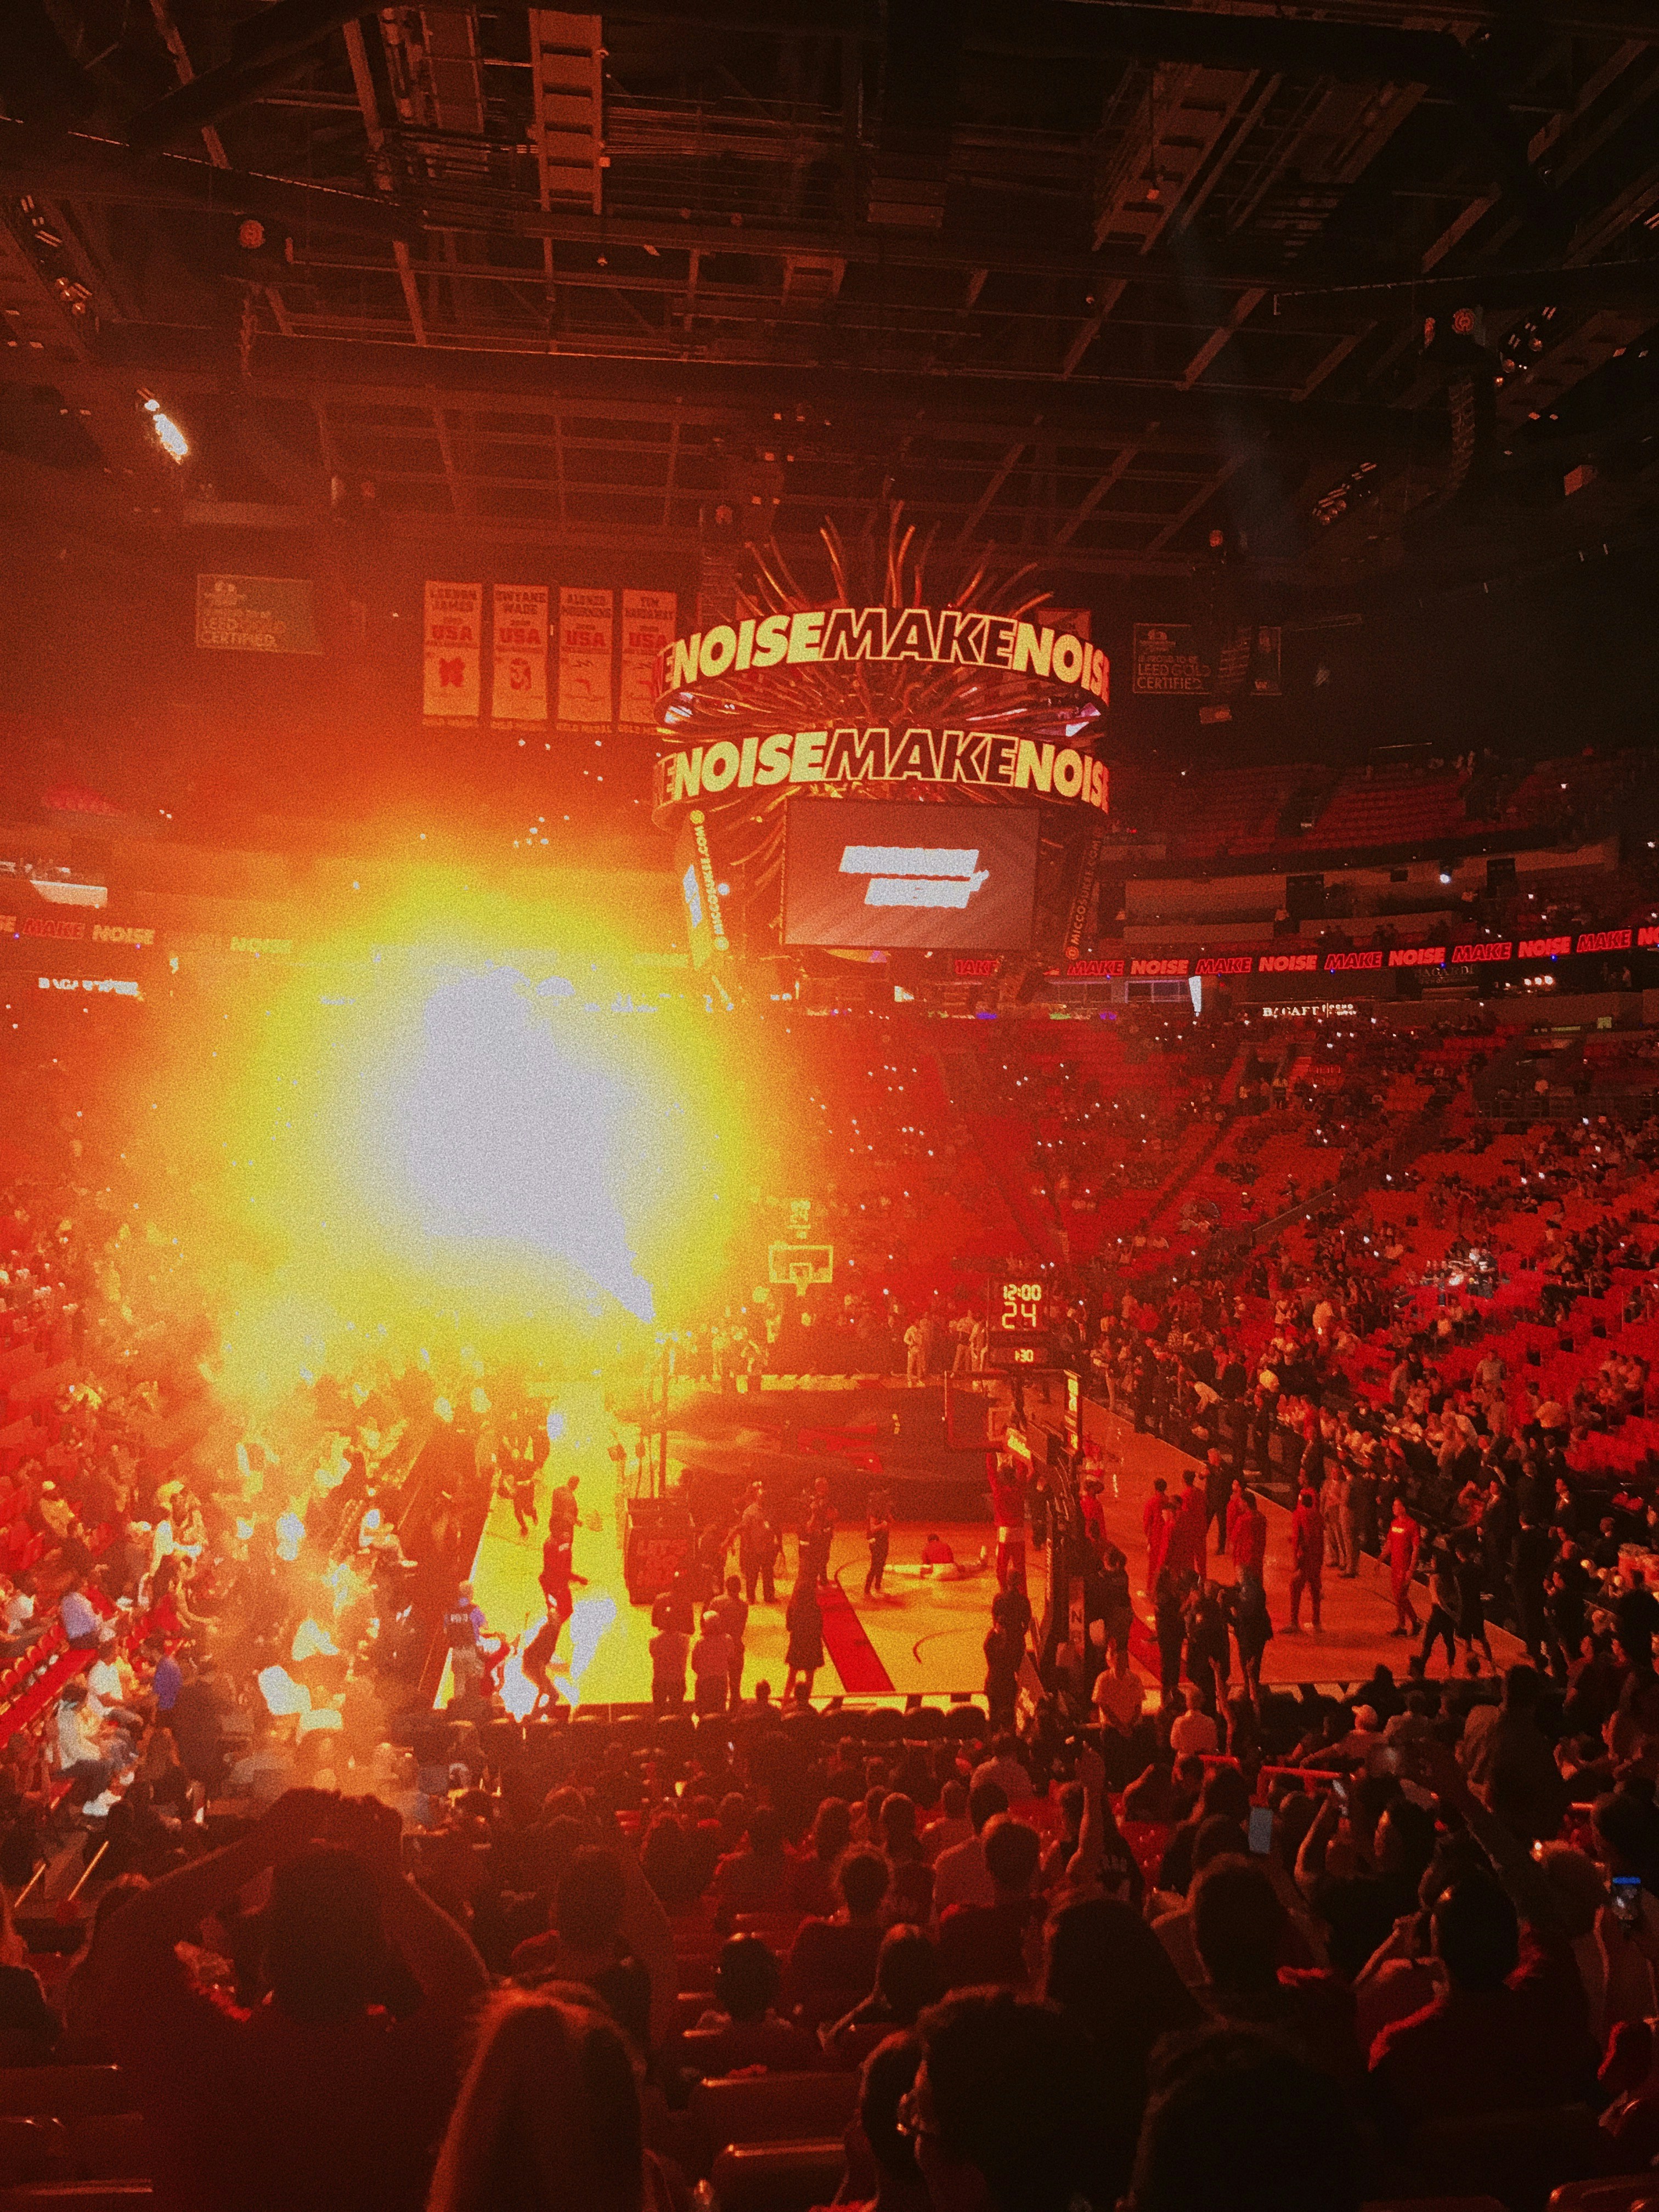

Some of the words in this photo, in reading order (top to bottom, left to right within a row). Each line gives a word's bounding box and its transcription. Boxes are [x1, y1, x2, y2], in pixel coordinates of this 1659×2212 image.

[432, 625, 472, 640] USA
[499, 628, 541, 644] USA
[566, 630, 606, 646] USA
[629, 633, 668, 648] USA
[673, 611, 826, 688] NOISE
[820, 608, 1018, 670] MAKE
[1138, 663, 1169, 676] LEED
[1171, 663, 1211, 677] GOLD
[1137, 676, 1203, 690] CERTIFIED
[672, 731, 829, 800] NOISE
[823, 727, 1019, 788] MAKE
[23, 918, 84, 940] MAKE
[93, 925, 155, 945] NOISE
[1068, 960, 1124, 976] MAKE
[1131, 959, 1189, 975] NOISE
[1195, 957, 1252, 974] MAKE
[1259, 955, 1317, 972] NOISE
[1324, 951, 1382, 970] MAKE
[1389, 947, 1446, 966] NOISE
[1452, 942, 1512, 963] MAKE
[1518, 936, 1571, 958] NOISE
[1576, 930, 1632, 952] MAKE
[1003, 1284, 1041, 1301] 12:00
[1002, 1301, 1036, 1329] 24
[1015, 1349, 1034, 1363] 1:30
